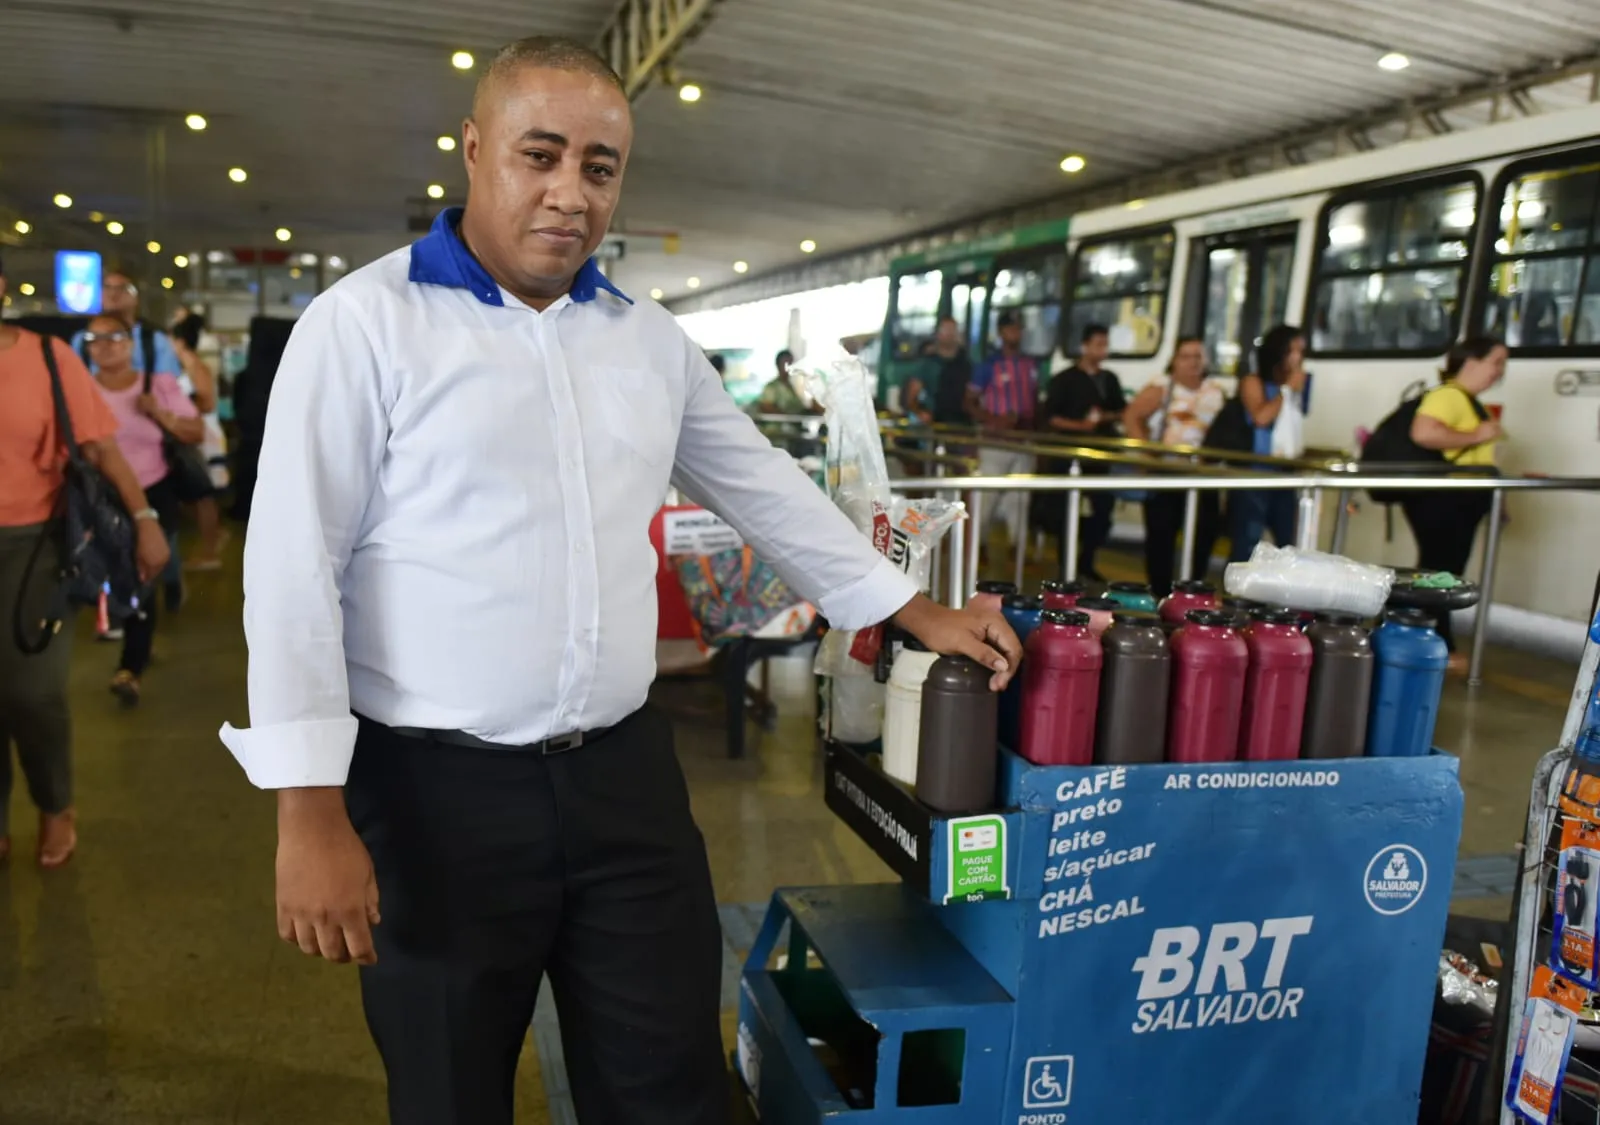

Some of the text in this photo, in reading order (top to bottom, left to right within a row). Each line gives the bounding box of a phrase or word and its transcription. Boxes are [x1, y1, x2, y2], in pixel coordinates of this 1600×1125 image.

[1056, 766, 1127, 802] CAFÉ
[1164, 771, 1340, 790] AR CONDICIONADO
[1052, 798, 1122, 832] preto
[1048, 830, 1106, 857] leite
[962, 855, 993, 867] PAGUE
[967, 865, 989, 876] COM
[1044, 842, 1156, 882] s/açúcar
[958, 872, 997, 886] CARTÃO
[1368, 880, 1420, 892] SALVADOR
[1039, 878, 1094, 912] CHÁ
[1038, 896, 1145, 938] NESCAL
[1131, 915, 1314, 1000] BRT
[1131, 987, 1304, 1034] SALVADOR
[1018, 1113, 1066, 1125] PONTO
